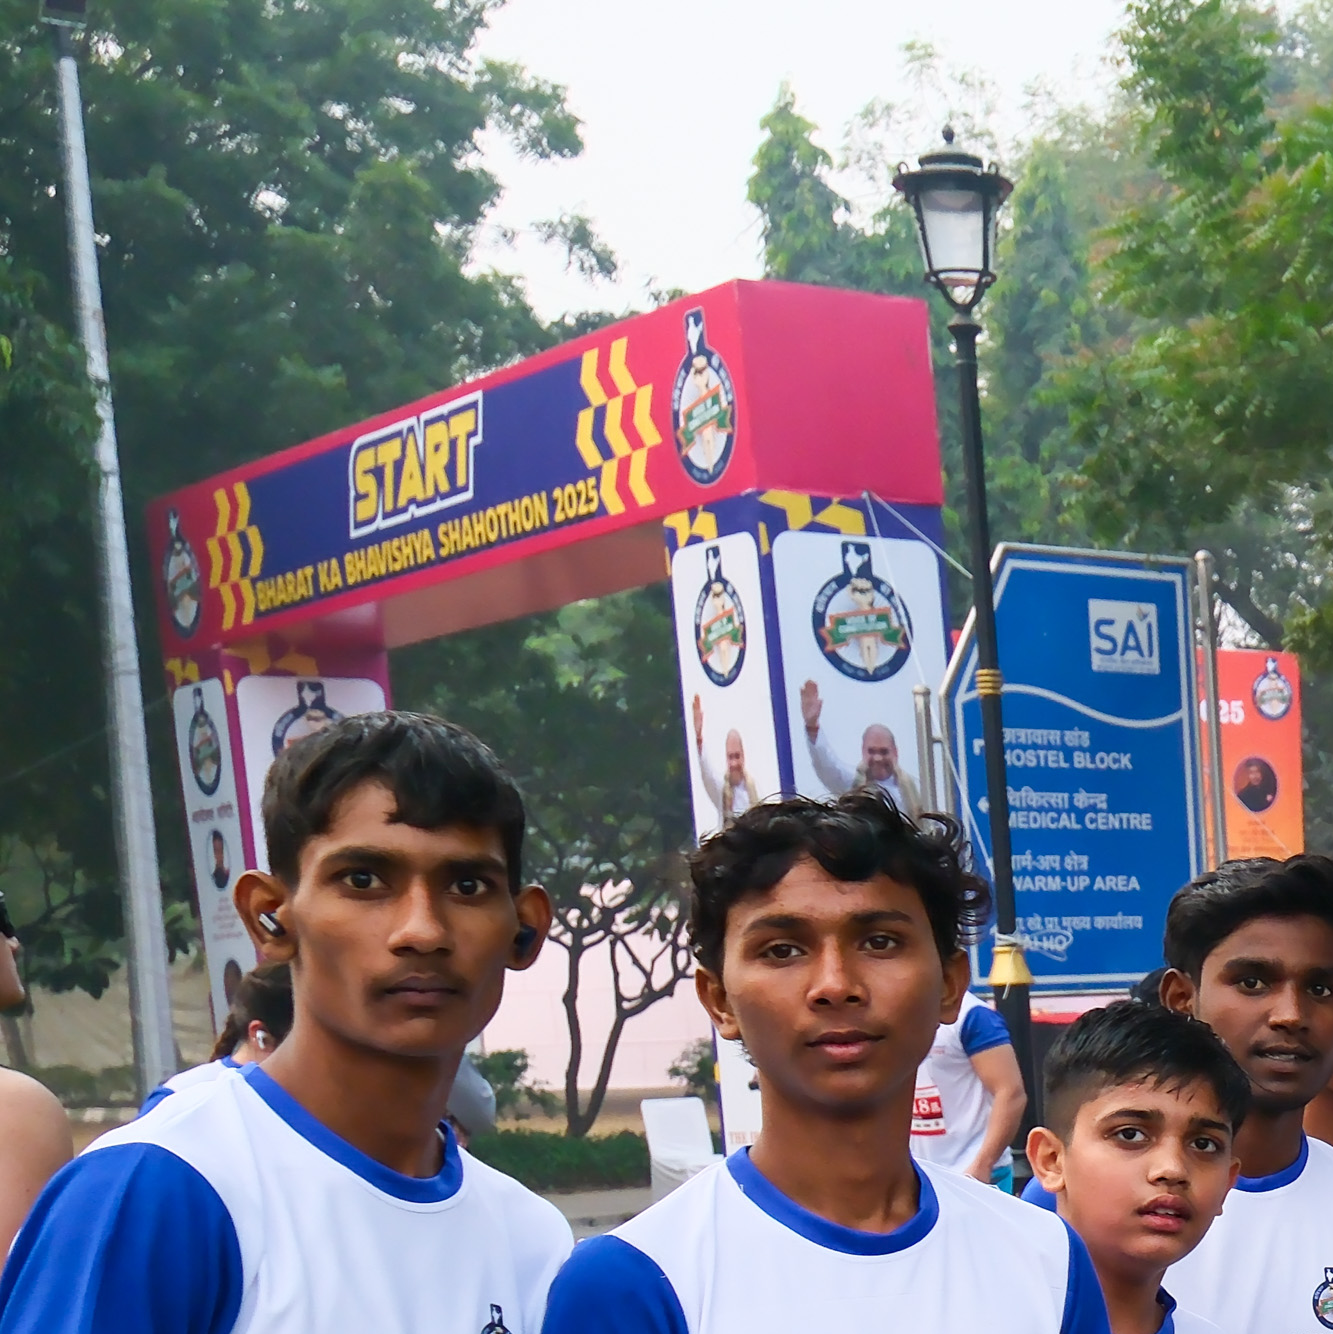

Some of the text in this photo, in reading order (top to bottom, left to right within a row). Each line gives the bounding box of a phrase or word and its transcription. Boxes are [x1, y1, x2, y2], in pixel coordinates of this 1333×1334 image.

[355, 409, 476, 521] START
[255, 477, 599, 611] BHARAT KA BHAVISHYA SHAHOTHON 2025
[1094, 619, 1153, 658] SAI
[1073, 752, 1132, 769] BLOCK
[1008, 812, 1152, 829] MEDICAL CENTRE
[1011, 850, 1060, 871] ार्म-अप
[1013, 876, 1140, 891] WARM-UP AREA
